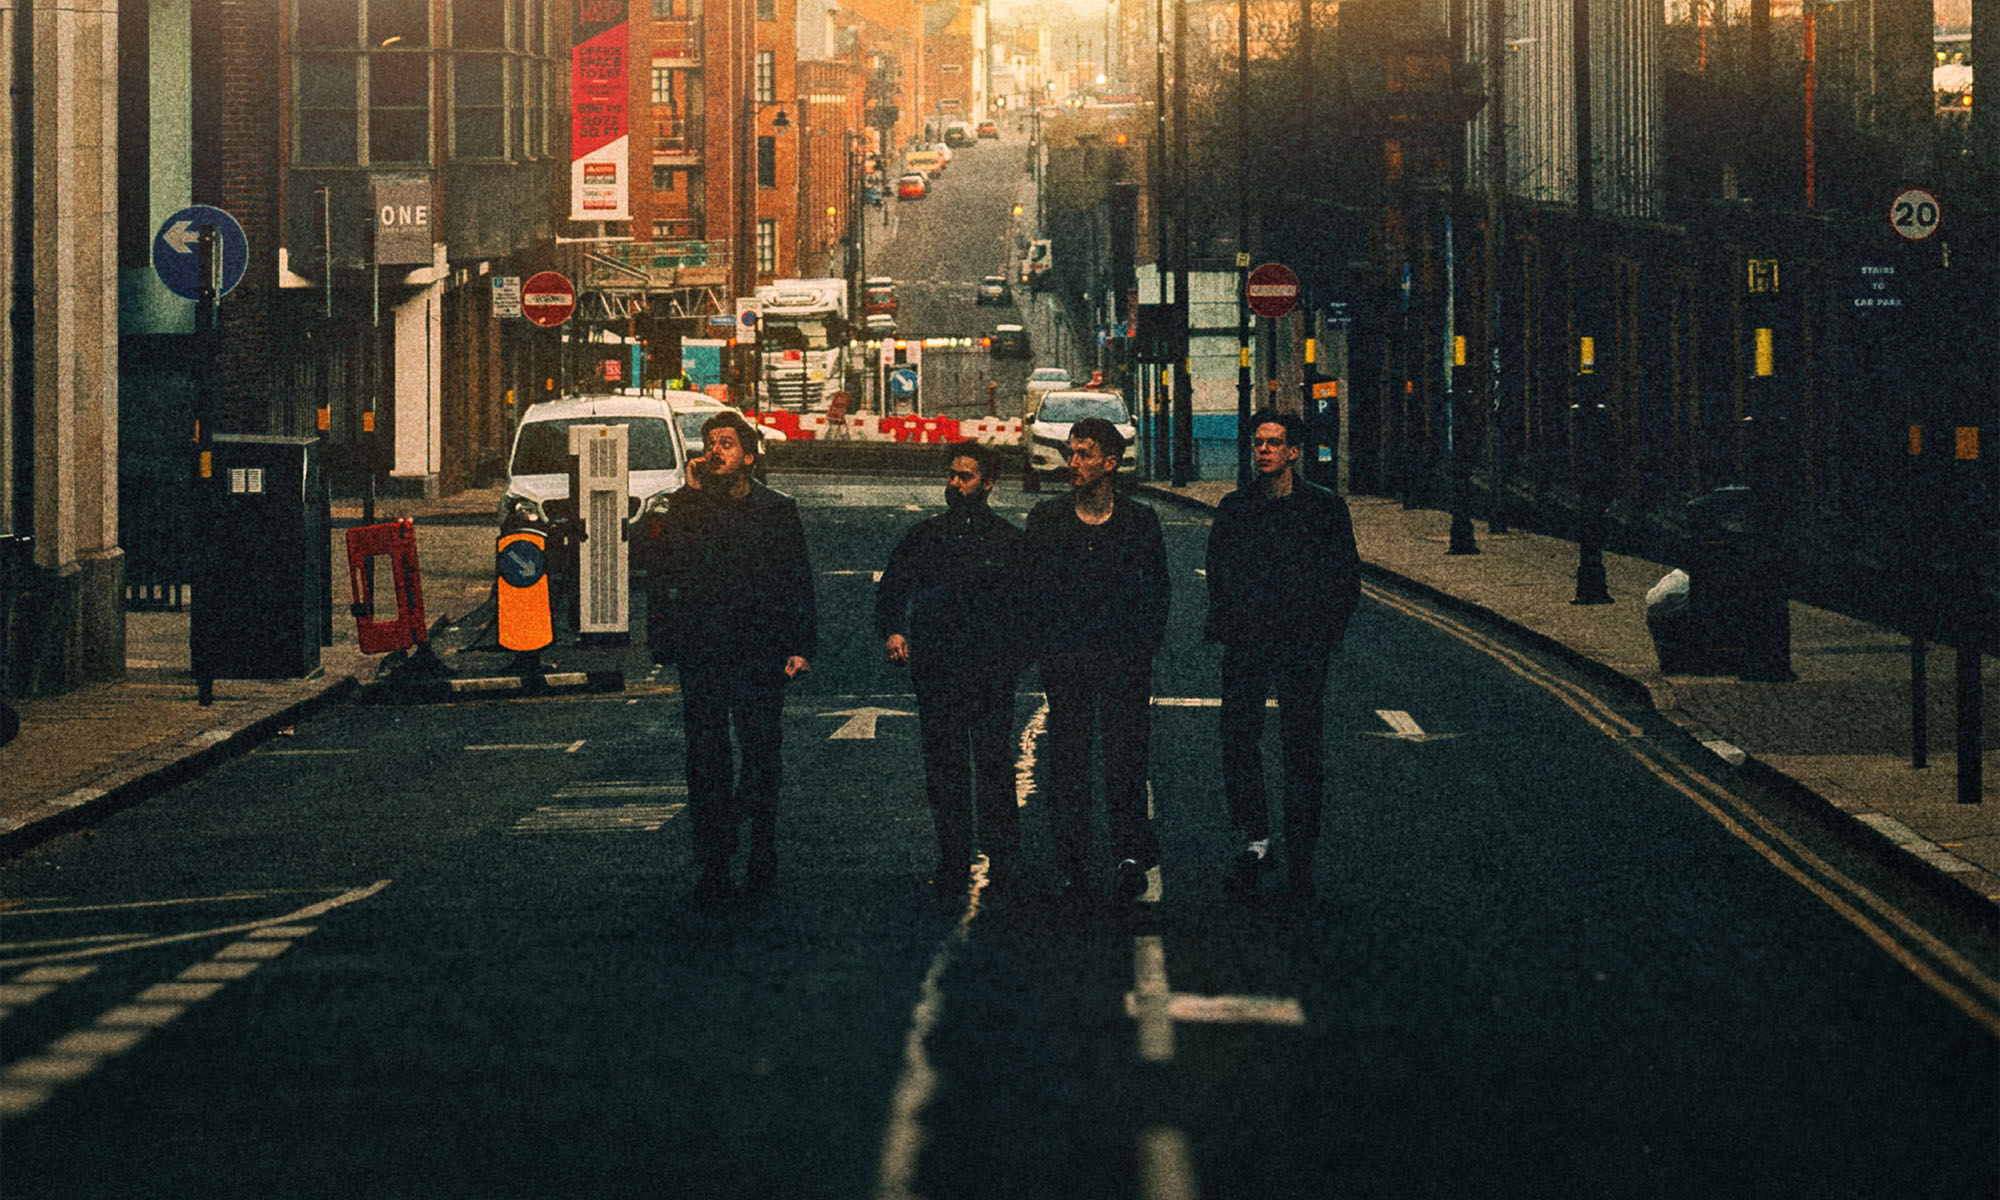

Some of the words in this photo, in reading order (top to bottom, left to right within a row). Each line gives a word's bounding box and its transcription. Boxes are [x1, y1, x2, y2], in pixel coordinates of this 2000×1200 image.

[578, 46, 622, 56] OFFICE
[579, 57, 621, 67] SPACE
[580, 68, 597, 78] TO
[598, 68, 621, 78] LET
[606, 103, 622, 114] TO
[580, 127, 599, 138] SQ
[603, 127, 620, 137] FT
[381, 205, 427, 225] ONE
[1895, 202, 1937, 227] 20
[1861, 266, 1895, 274] STAIRS
[1872, 282, 1886, 290] TO
[1854, 298, 1874, 306] CAR
[1877, 298, 1902, 306] PARK
[1318, 401, 1328, 414] P
